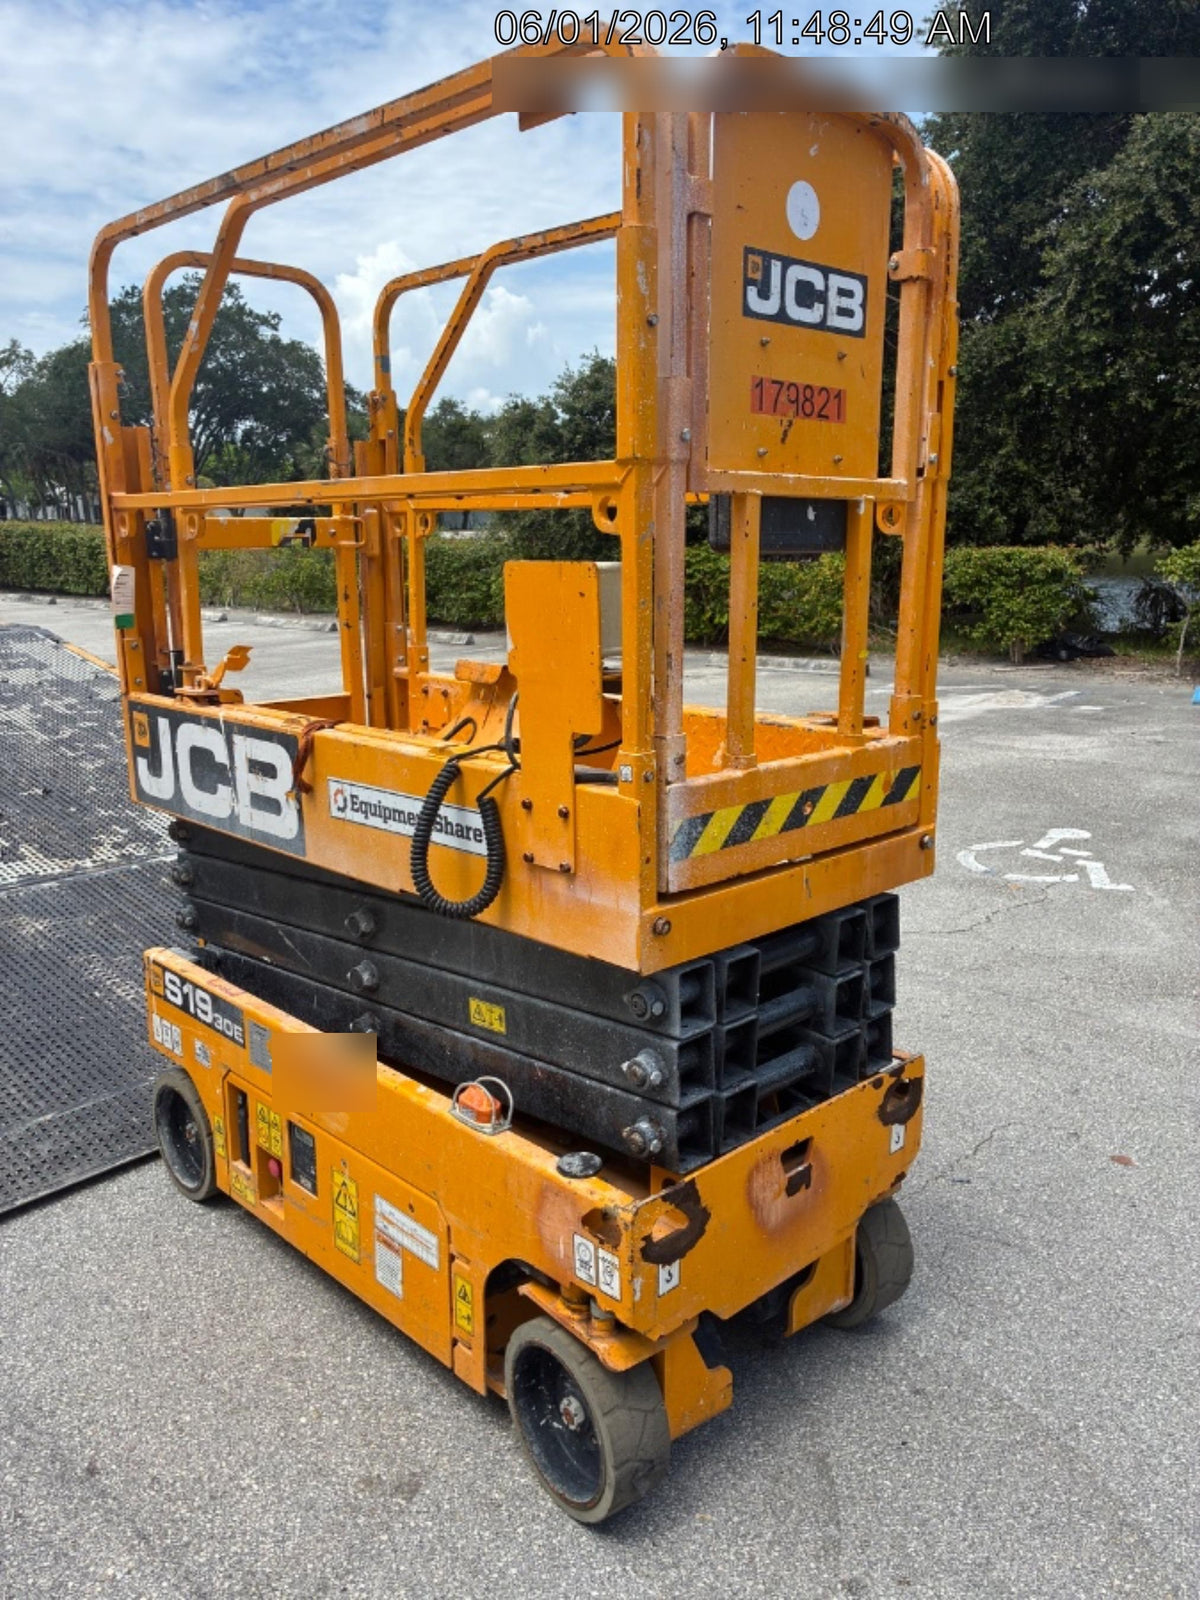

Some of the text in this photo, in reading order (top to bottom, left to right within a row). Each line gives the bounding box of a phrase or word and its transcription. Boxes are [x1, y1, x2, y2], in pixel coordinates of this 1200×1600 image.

[746, 259, 865, 332] JCB
[755, 377, 842, 420] 179821
[136, 717, 299, 840] JCB
[350, 794, 484, 844] EquipmeShare
